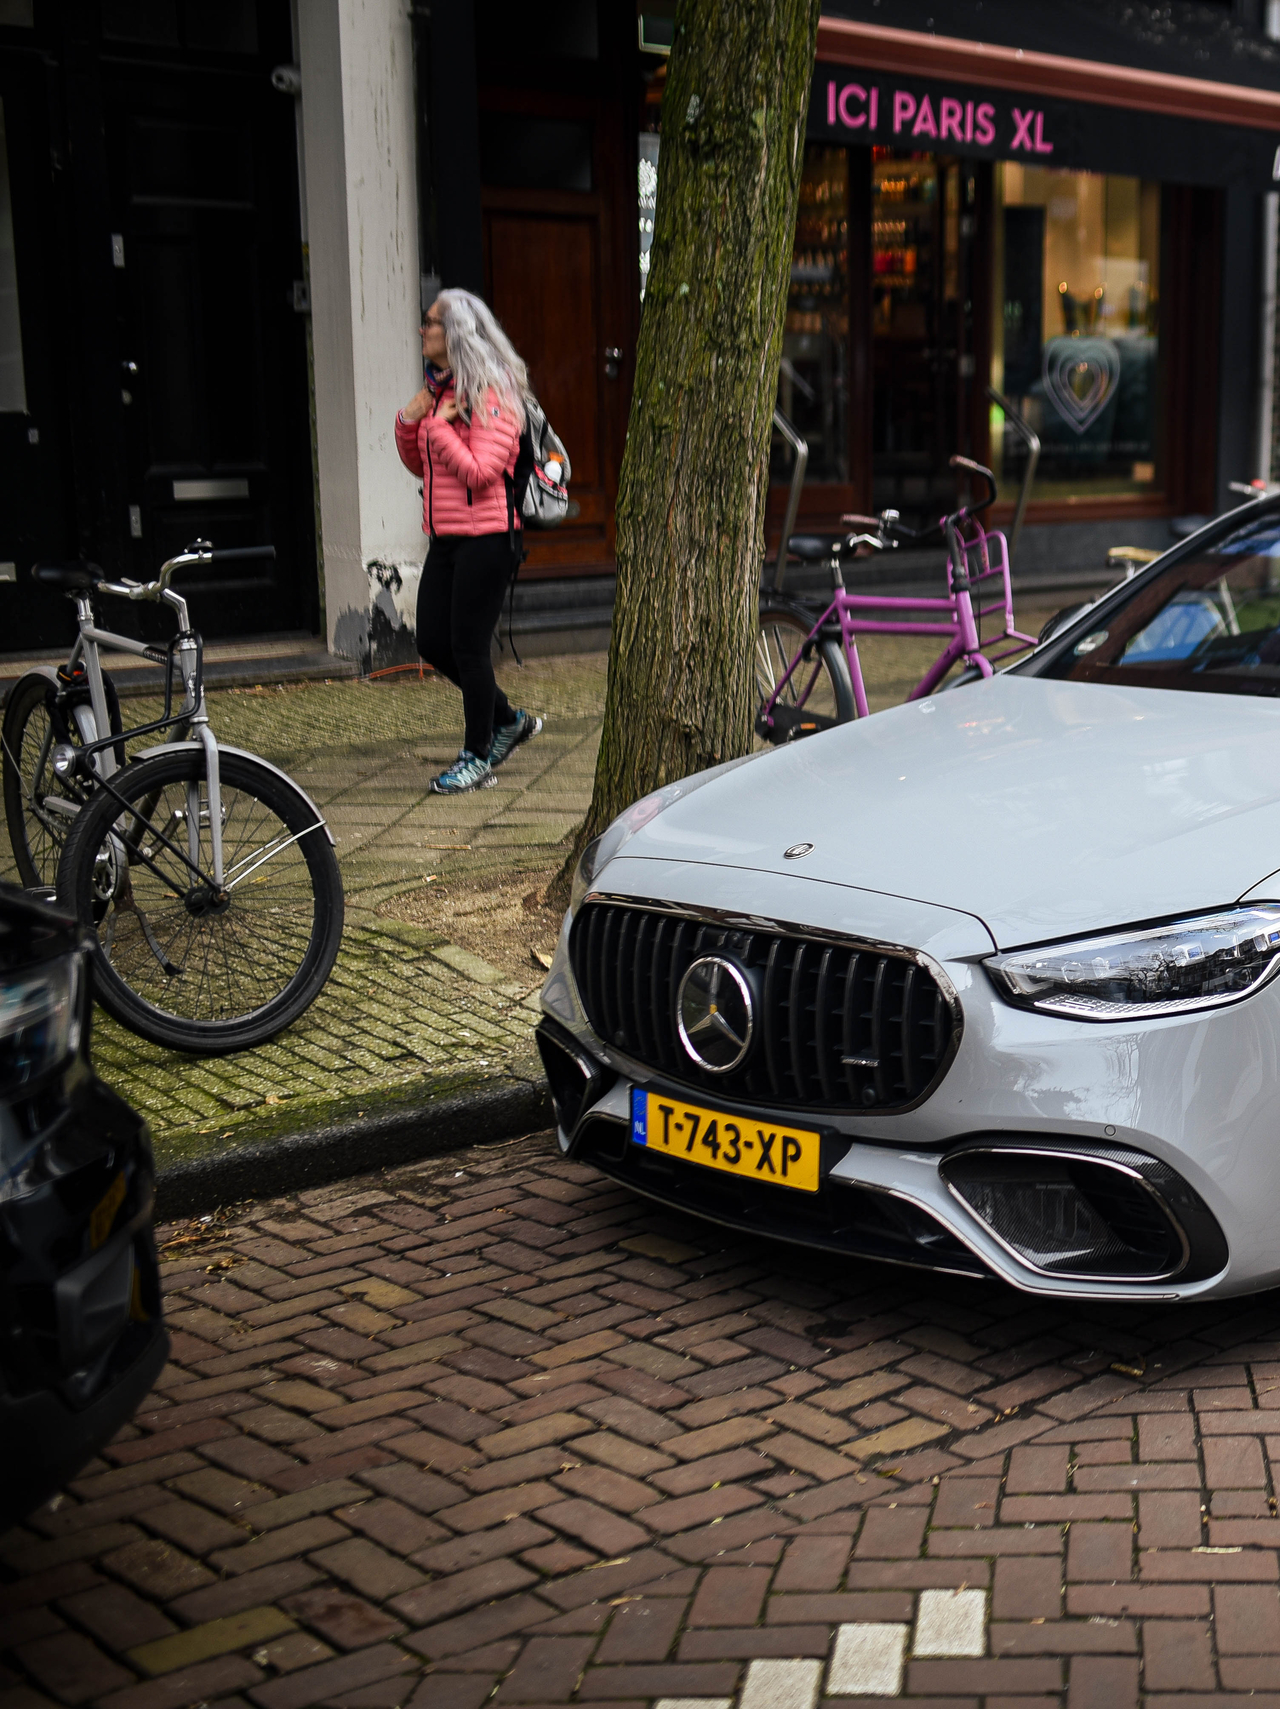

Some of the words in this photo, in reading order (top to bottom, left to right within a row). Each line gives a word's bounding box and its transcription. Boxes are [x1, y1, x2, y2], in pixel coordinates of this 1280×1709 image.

[827, 80, 880, 131] ICI
[892, 90, 997, 146] PARIS
[1009, 107, 1055, 154] XL
[633, 1120, 647, 1136] NL
[658, 1103, 803, 1178] T-743-XP
